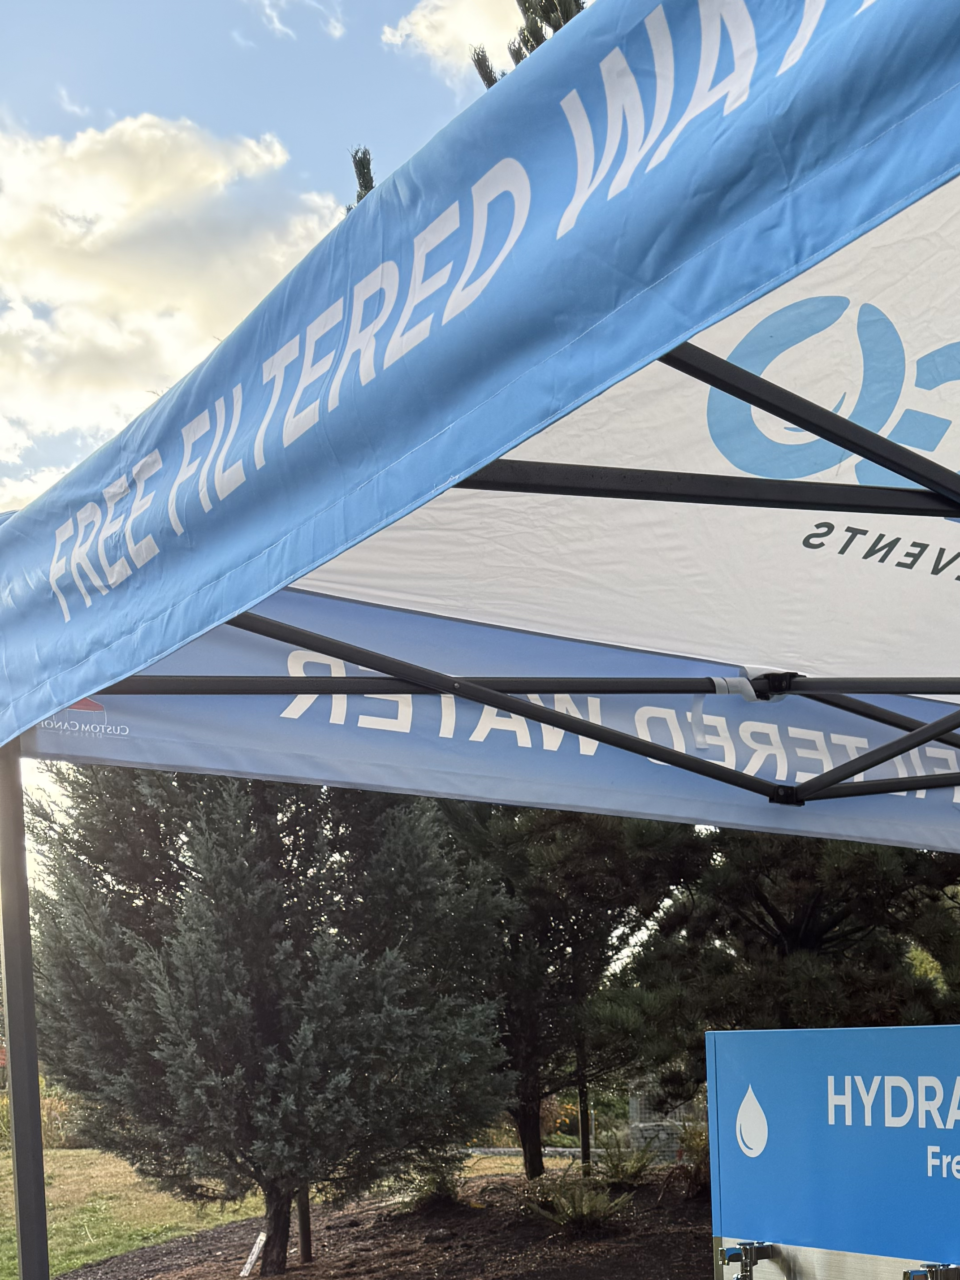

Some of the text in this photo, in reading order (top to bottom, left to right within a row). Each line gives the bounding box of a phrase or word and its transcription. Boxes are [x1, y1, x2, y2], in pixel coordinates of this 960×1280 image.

[50, 0, 873, 623] FREE FILTERED WA
